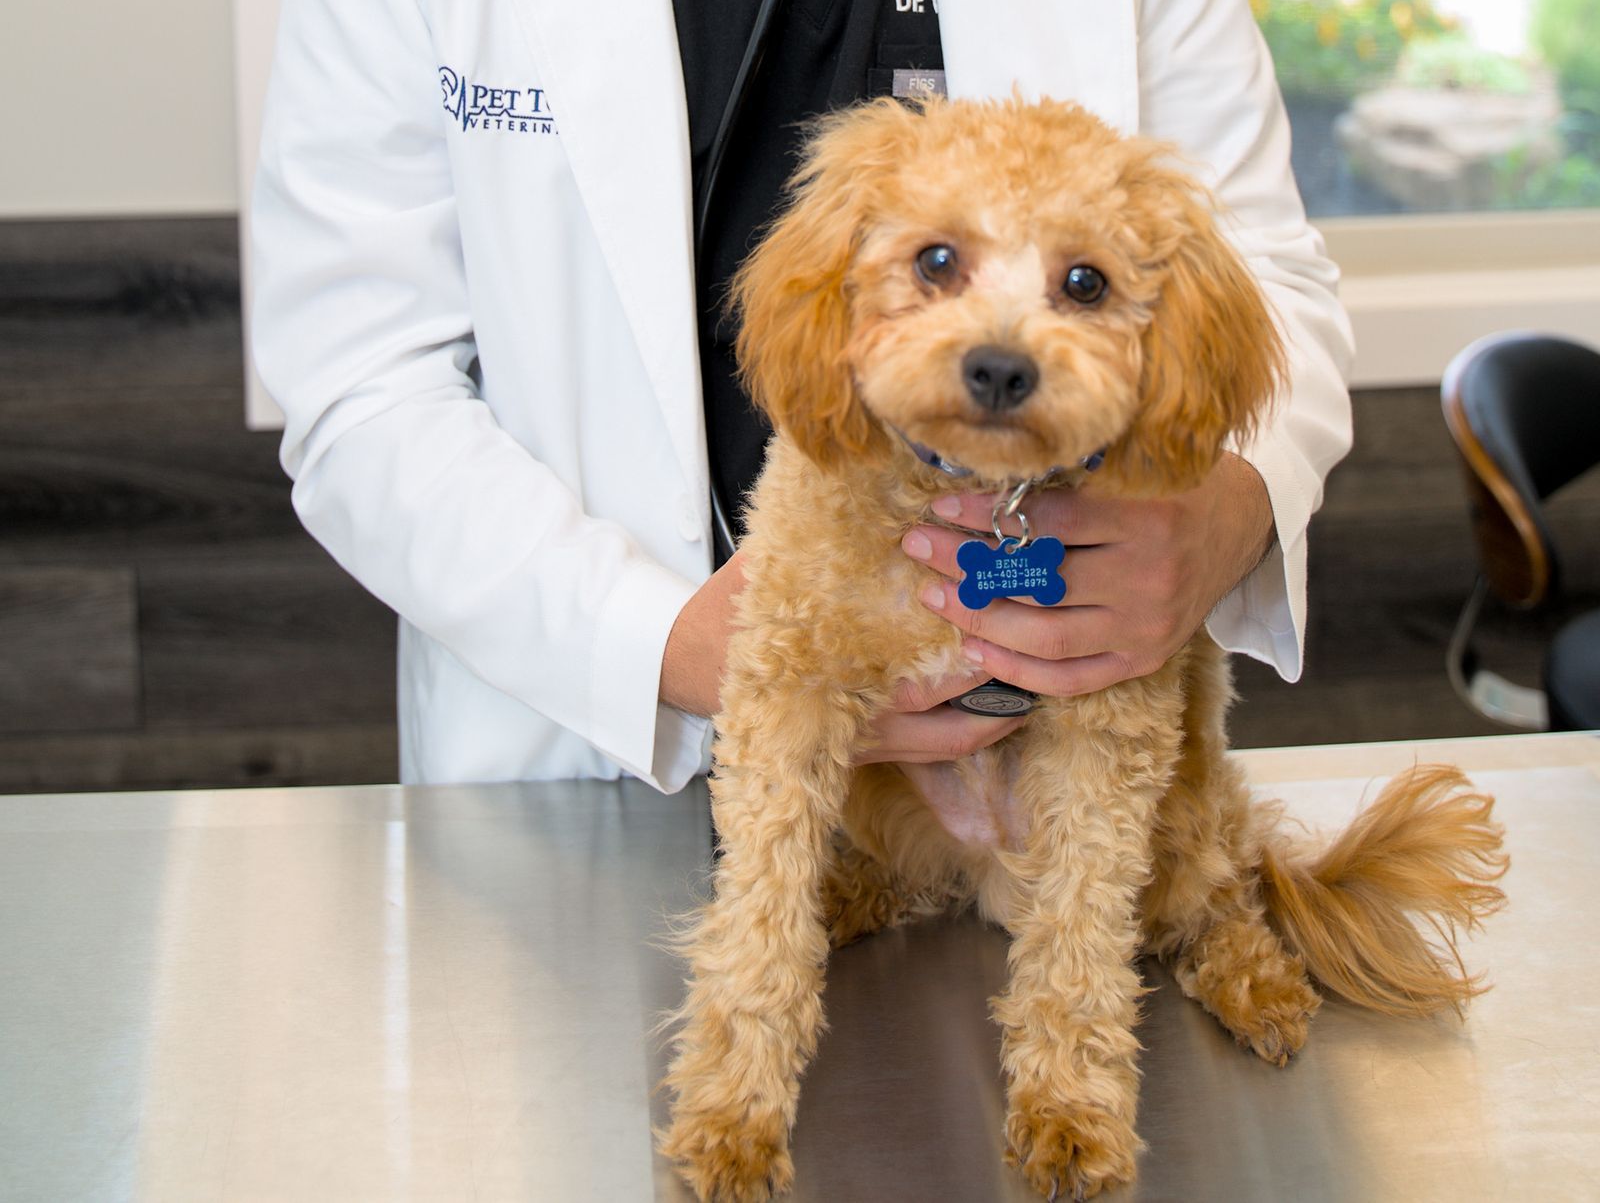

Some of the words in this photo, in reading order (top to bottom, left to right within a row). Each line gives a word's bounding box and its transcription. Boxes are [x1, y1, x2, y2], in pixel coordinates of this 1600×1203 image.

[470, 84, 521, 110] PET
[527, 87, 551, 112] T
[469, 117, 559, 135] VETERIN
[995, 558, 1029, 569] BENJI
[976, 567, 1048, 580] 914-403-3224
